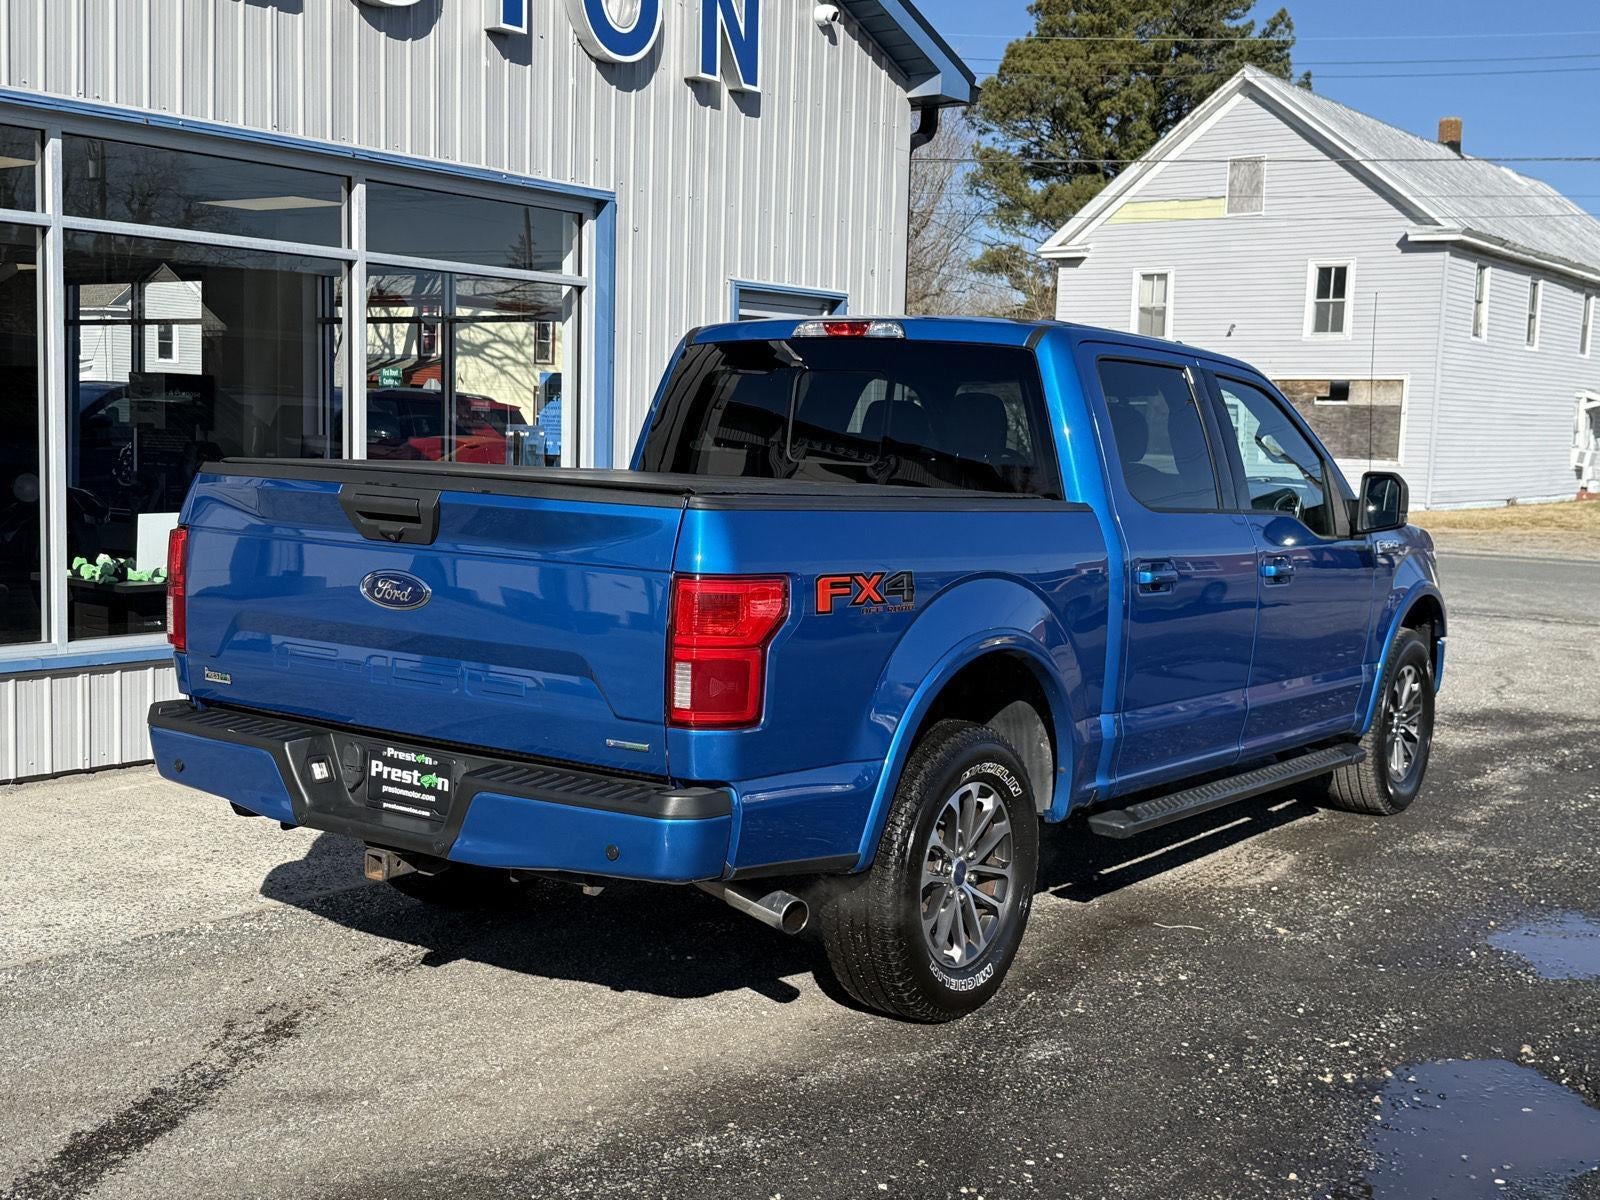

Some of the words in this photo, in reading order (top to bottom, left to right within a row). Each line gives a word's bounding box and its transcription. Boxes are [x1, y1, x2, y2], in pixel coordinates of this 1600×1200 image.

[374, 578, 413, 602] Ford
[814, 570, 916, 616] FX4
[382, 785, 436, 802] prestonmotor.com
[960, 762, 1023, 798] MICHELIN
[929, 960, 994, 992] MICHELIN
